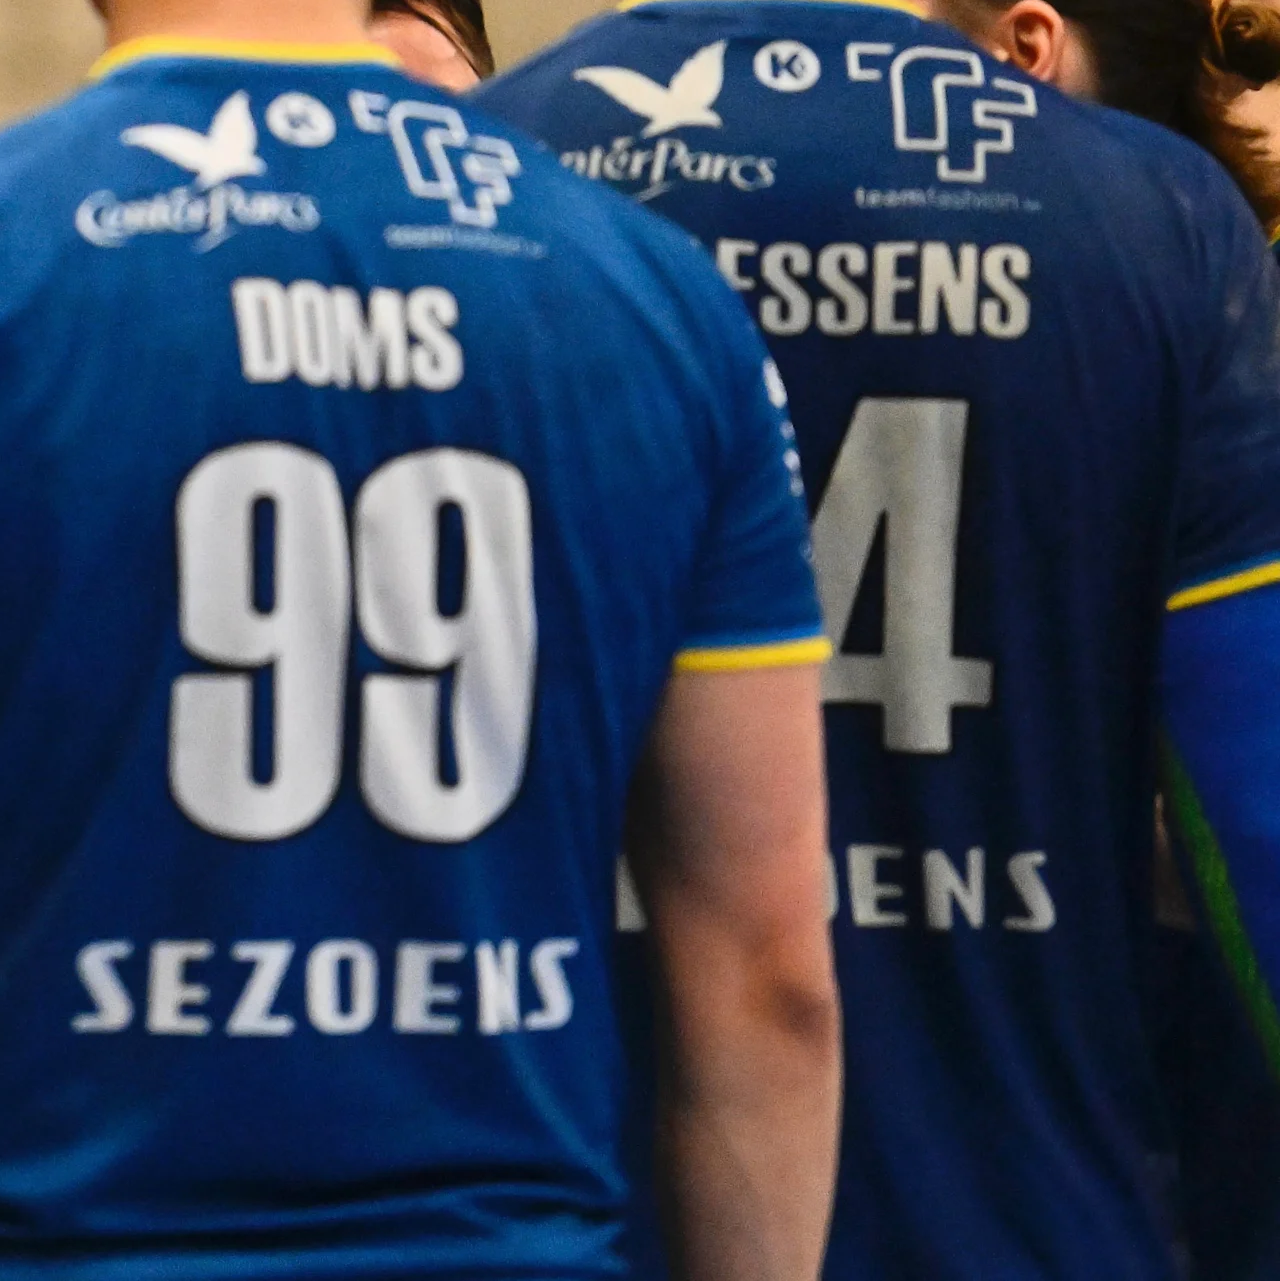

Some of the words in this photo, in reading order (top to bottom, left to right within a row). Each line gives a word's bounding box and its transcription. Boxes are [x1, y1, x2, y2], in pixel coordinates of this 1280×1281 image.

[232, 276, 464, 392] DOMS
[168, 440, 538, 844] 99
[71, 937, 580, 1037] SEZOENS
